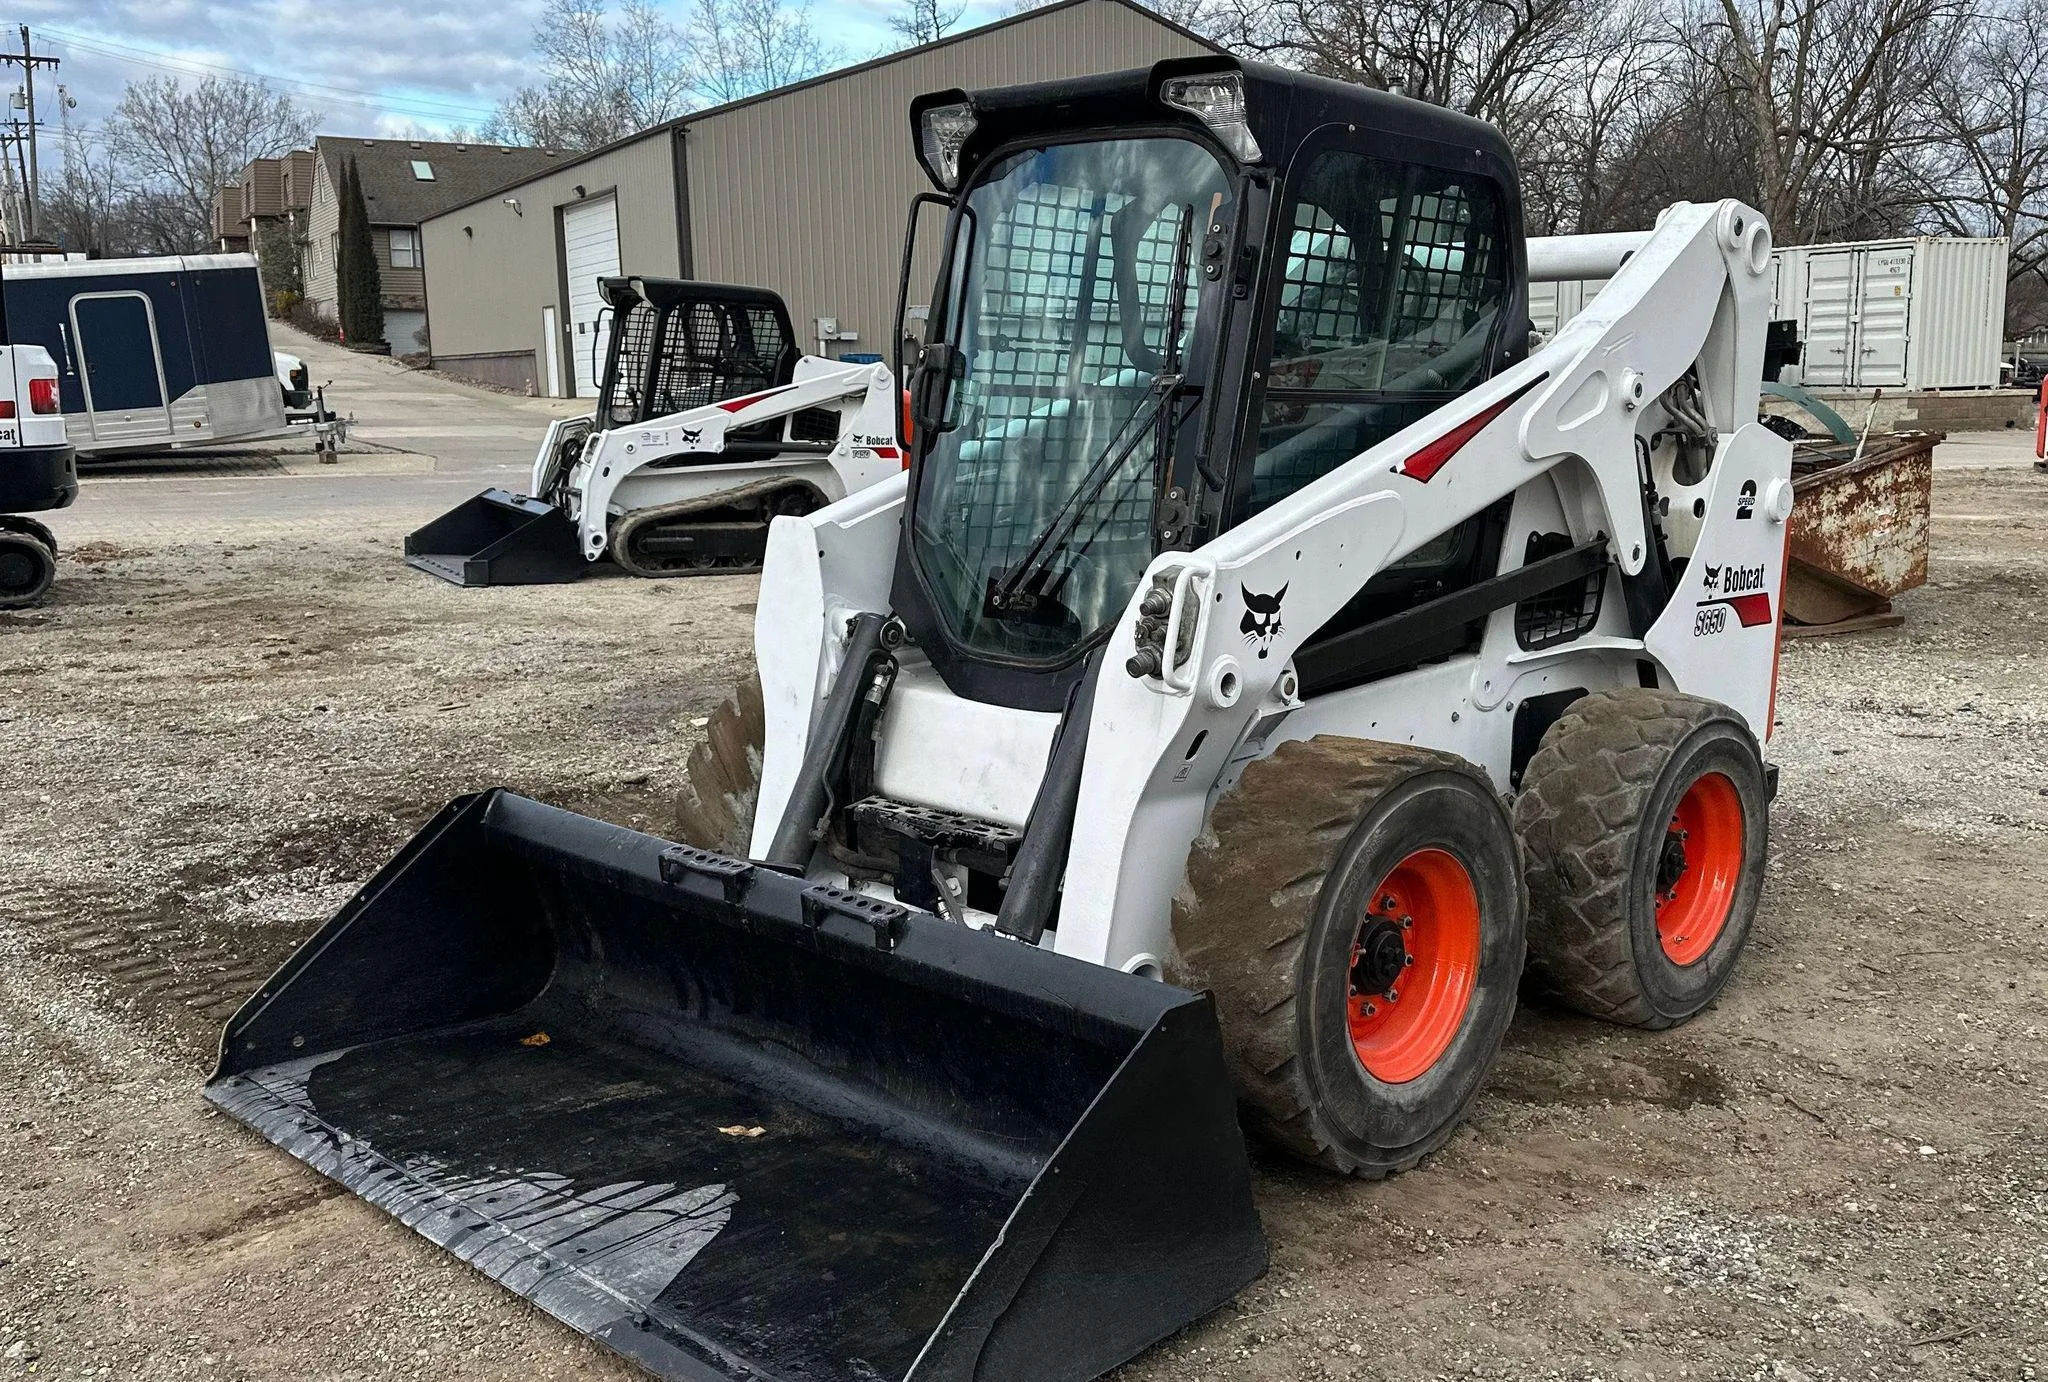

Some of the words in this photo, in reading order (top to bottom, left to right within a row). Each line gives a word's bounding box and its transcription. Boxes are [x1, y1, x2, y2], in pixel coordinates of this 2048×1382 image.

[866, 436, 893, 446] Bobcat
[1736, 479, 1757, 520] 2
[1738, 497, 1756, 506] SPEED
[1723, 563, 1765, 594] Bobcat
[1694, 607, 1727, 637] S650
